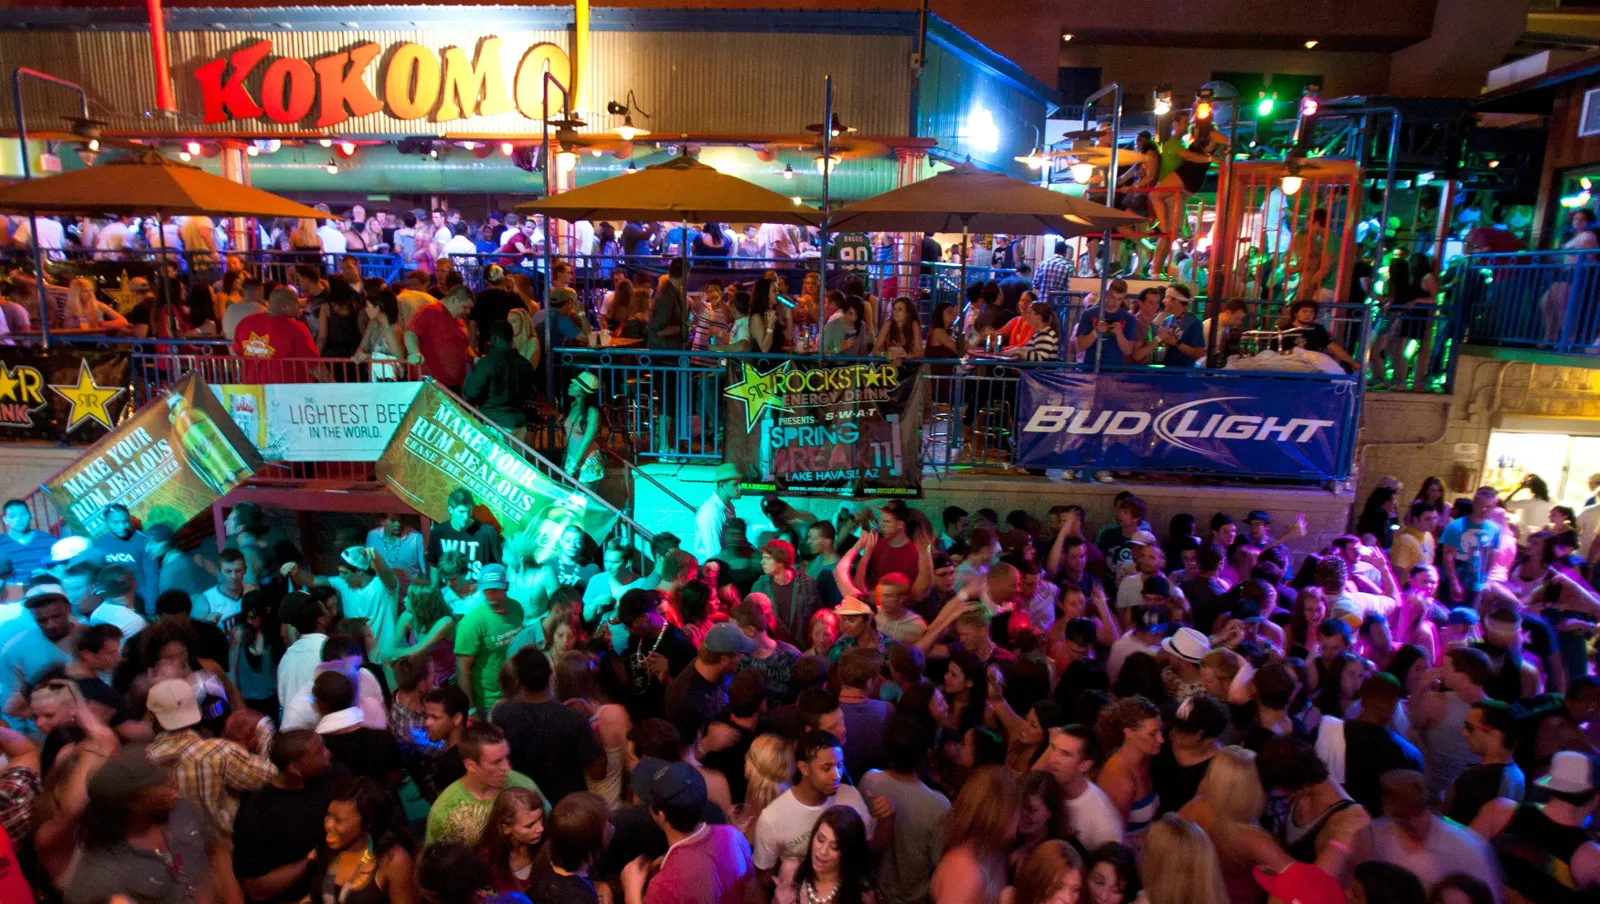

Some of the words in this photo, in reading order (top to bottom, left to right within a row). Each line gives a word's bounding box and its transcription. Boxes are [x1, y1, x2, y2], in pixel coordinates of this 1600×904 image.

[194, 35, 572, 127] KOKOMO
[840, 246, 868, 270] 90
[783, 391, 839, 406] ENERGY
[844, 387, 889, 401] DRINK
[289, 404, 369, 425] LIGHTEST
[375, 404, 412, 424] BEE
[778, 415, 815, 426] PRESENTS
[1022, 405, 1152, 436] BUD
[1172, 410, 1336, 442] LIGHT
[309, 427, 320, 438] IN
[323, 426, 341, 438] THE
[343, 426, 383, 438] WORLD.
[433, 403, 489, 453] MAKE
[488, 443, 537, 488] YOUR
[771, 421, 860, 448] SPRING
[62, 456, 113, 500] MAKE
[105, 426, 154, 466] YOUR
[410, 415, 456, 454] RUM
[454, 447, 536, 511] JEALOUS
[785, 470, 813, 482] LAKE
[864, 468, 880, 479] AZ
[69, 487, 110, 521] RUM
[105, 438, 174, 498] JEALOUS
[404, 436, 438, 463] CHASE
[439, 457, 461, 478] THE
[462, 474, 523, 521] UNEXPECTED
[440, 538, 480, 561] WIT
